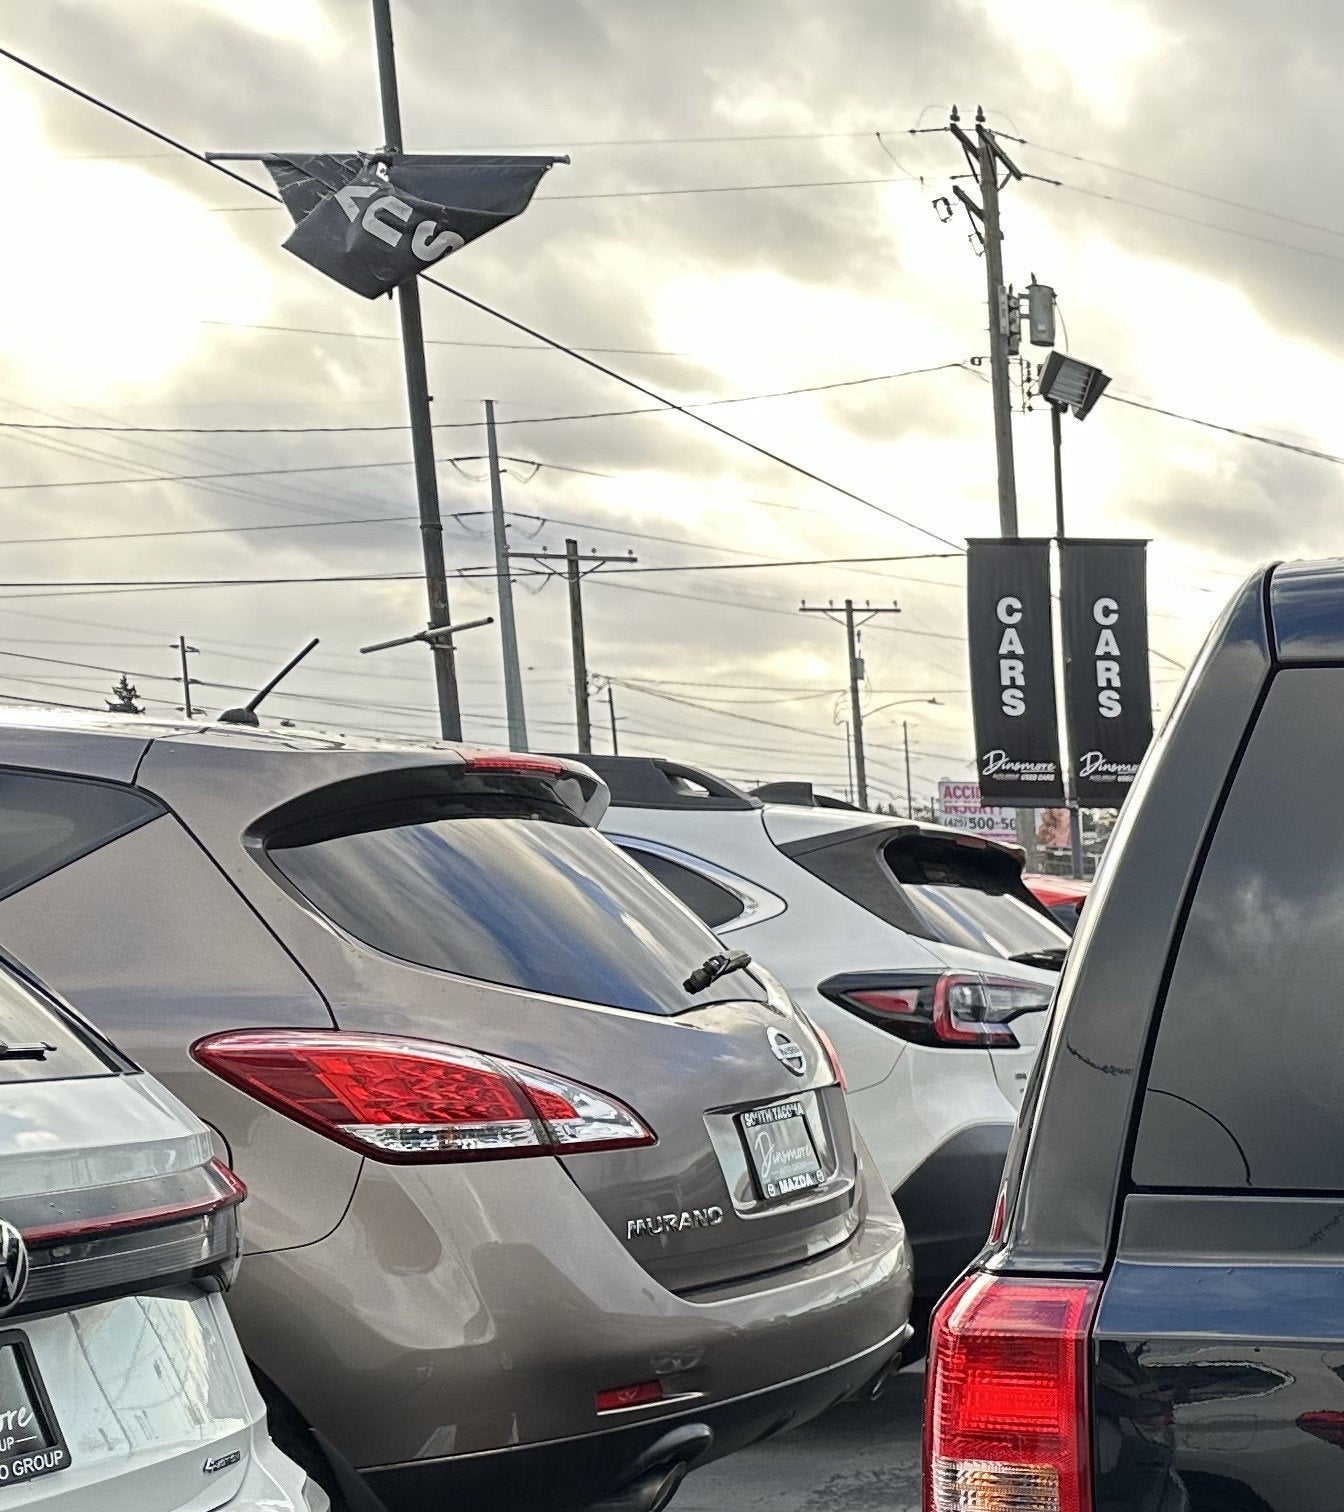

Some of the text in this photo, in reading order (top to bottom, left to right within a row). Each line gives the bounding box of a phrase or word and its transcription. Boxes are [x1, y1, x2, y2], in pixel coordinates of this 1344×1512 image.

[996, 596, 1026, 717] CARS
[1093, 597, 1122, 718] CARS
[982, 750, 1056, 775] Dinsmore
[754, 1131, 812, 1179] Dinsmore
[779, 1173, 813, 1194] MAZDA
[627, 1206, 723, 1239] MURANO
[12, 1450, 64, 1476] GROUP
